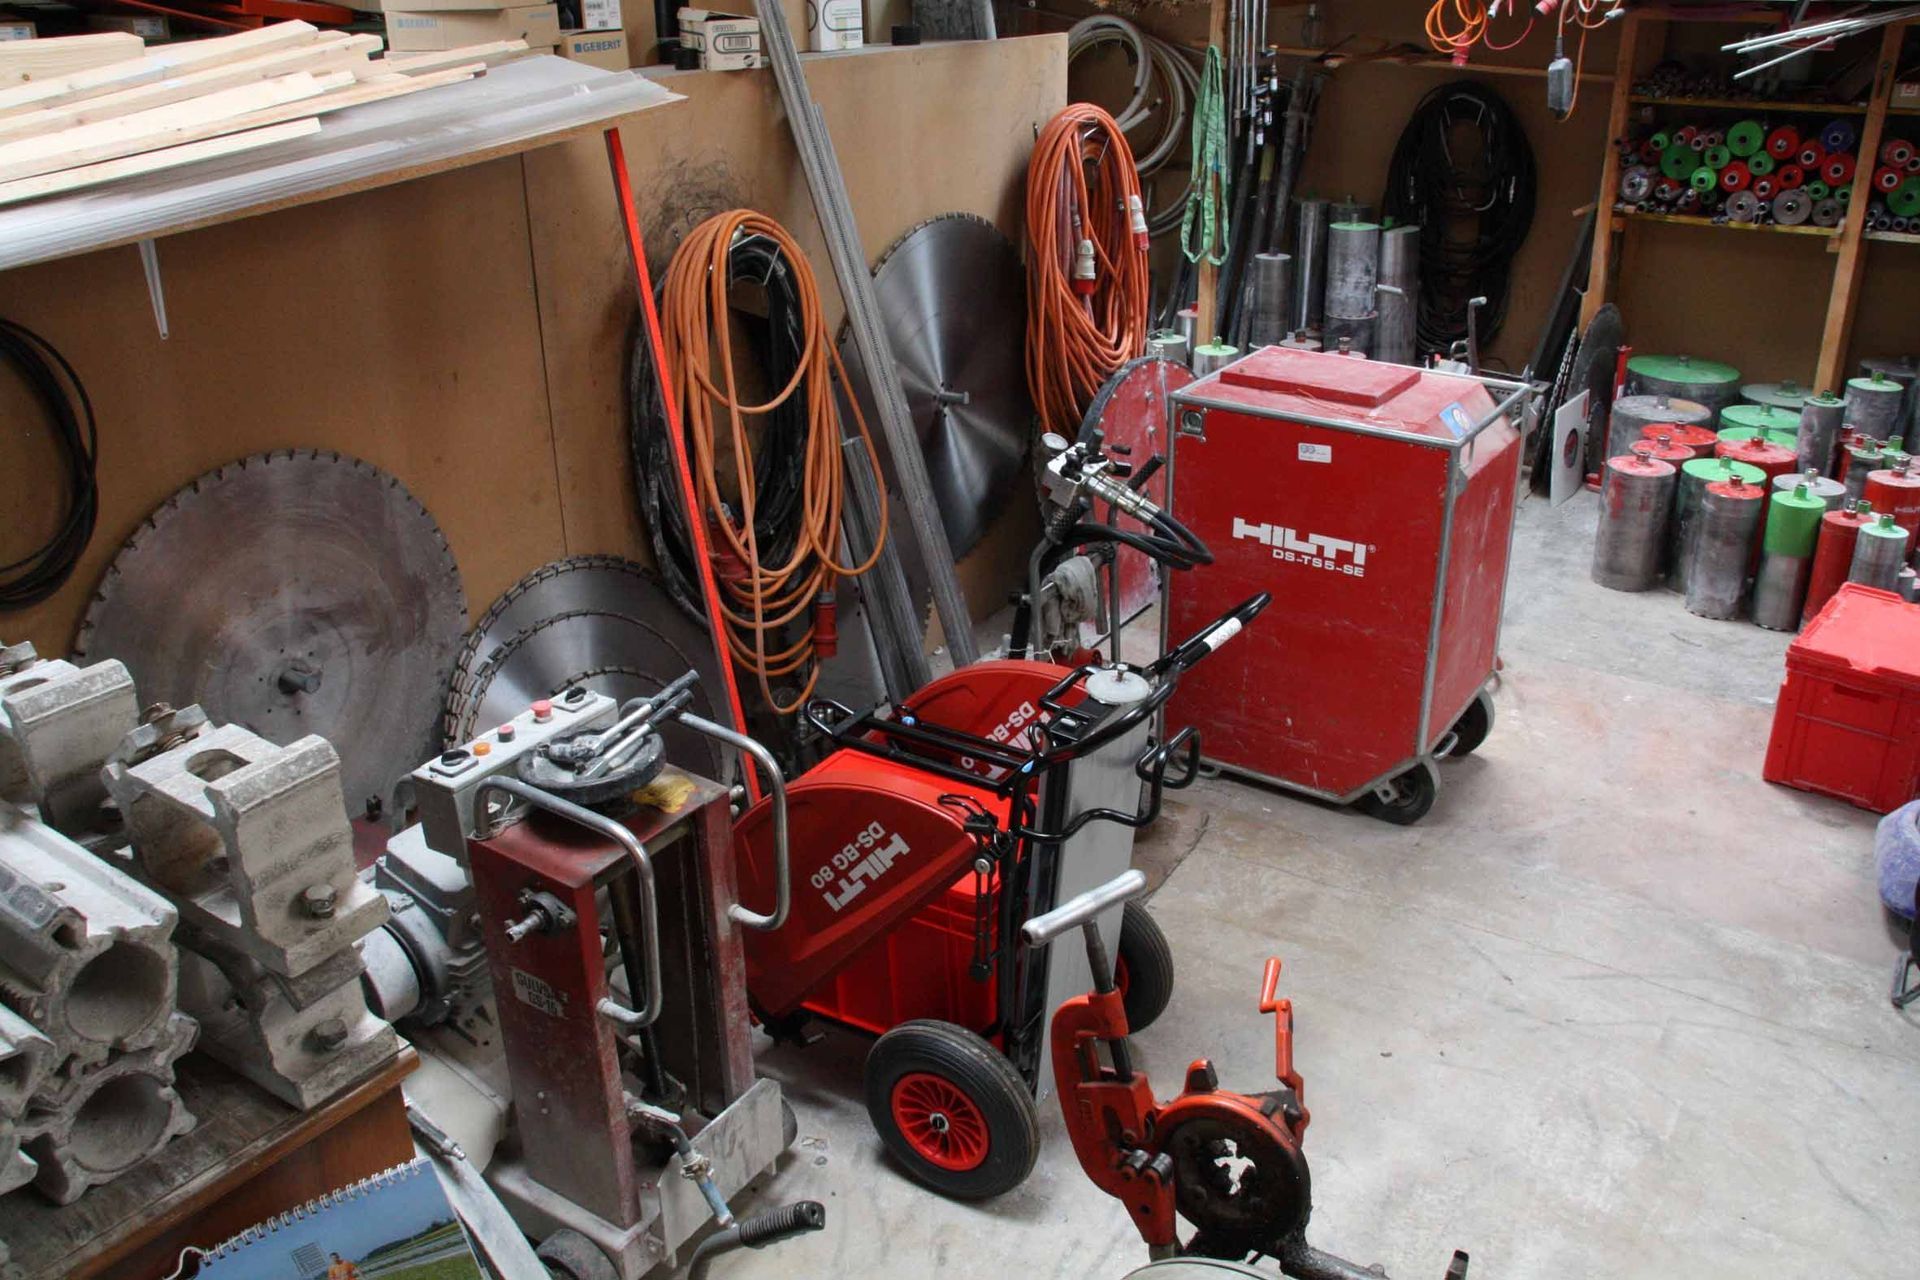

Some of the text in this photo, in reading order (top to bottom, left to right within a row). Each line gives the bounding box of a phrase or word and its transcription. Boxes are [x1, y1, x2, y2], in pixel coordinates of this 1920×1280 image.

[582, 39, 622, 53] GEBERIT
[1232, 516, 1367, 566] HILTI
[810, 865, 835, 889] 80
[822, 832, 911, 912] HILTI
